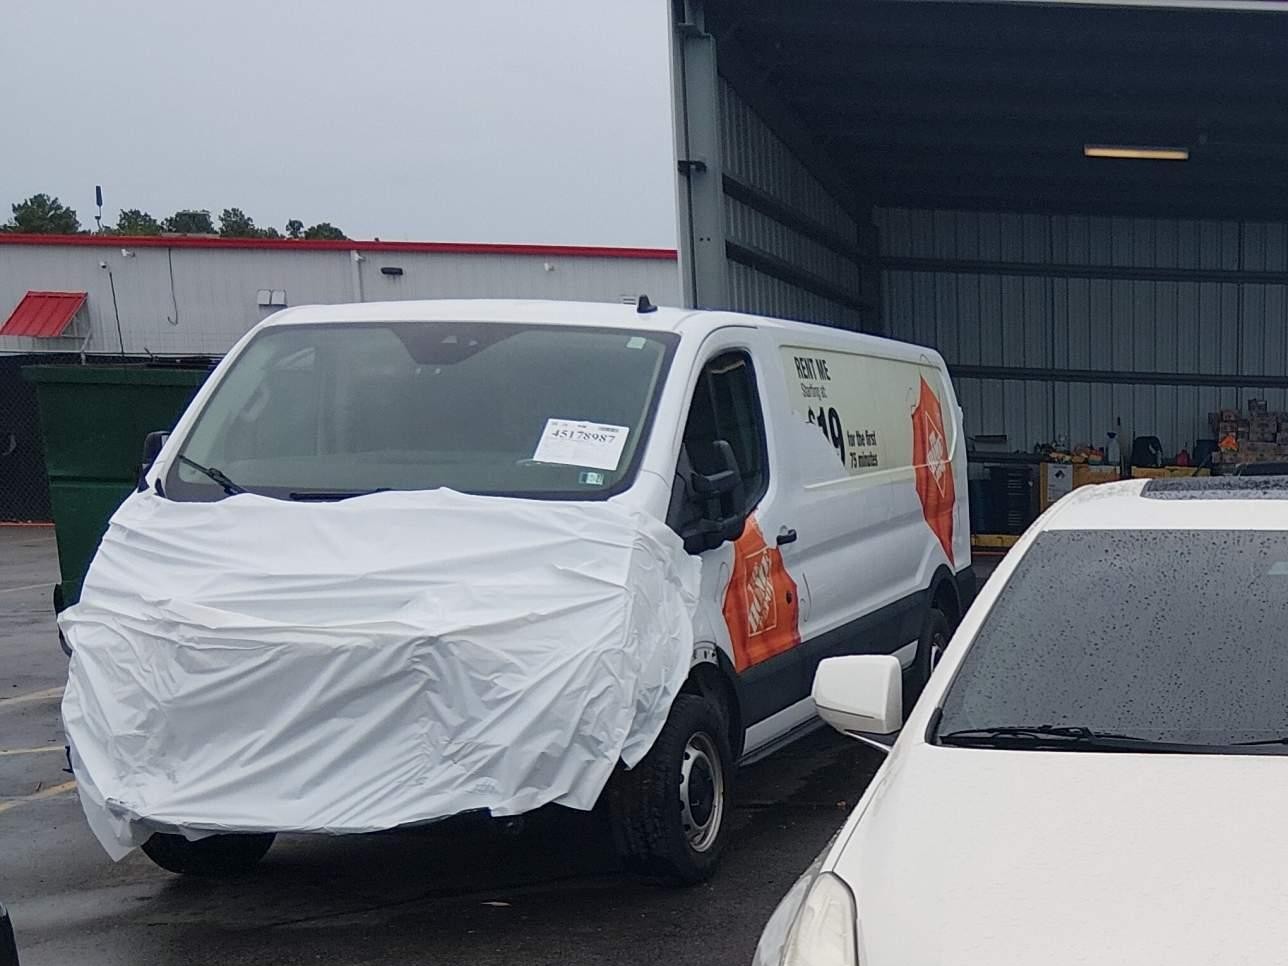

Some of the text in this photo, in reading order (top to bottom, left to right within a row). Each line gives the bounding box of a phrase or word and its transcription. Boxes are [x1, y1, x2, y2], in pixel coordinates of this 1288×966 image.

[794, 356, 831, 381] RENT ME
[552, 429, 616, 443] 45178987
[847, 429, 877, 447] for the first
[849, 451, 878, 469] 75 minutes
